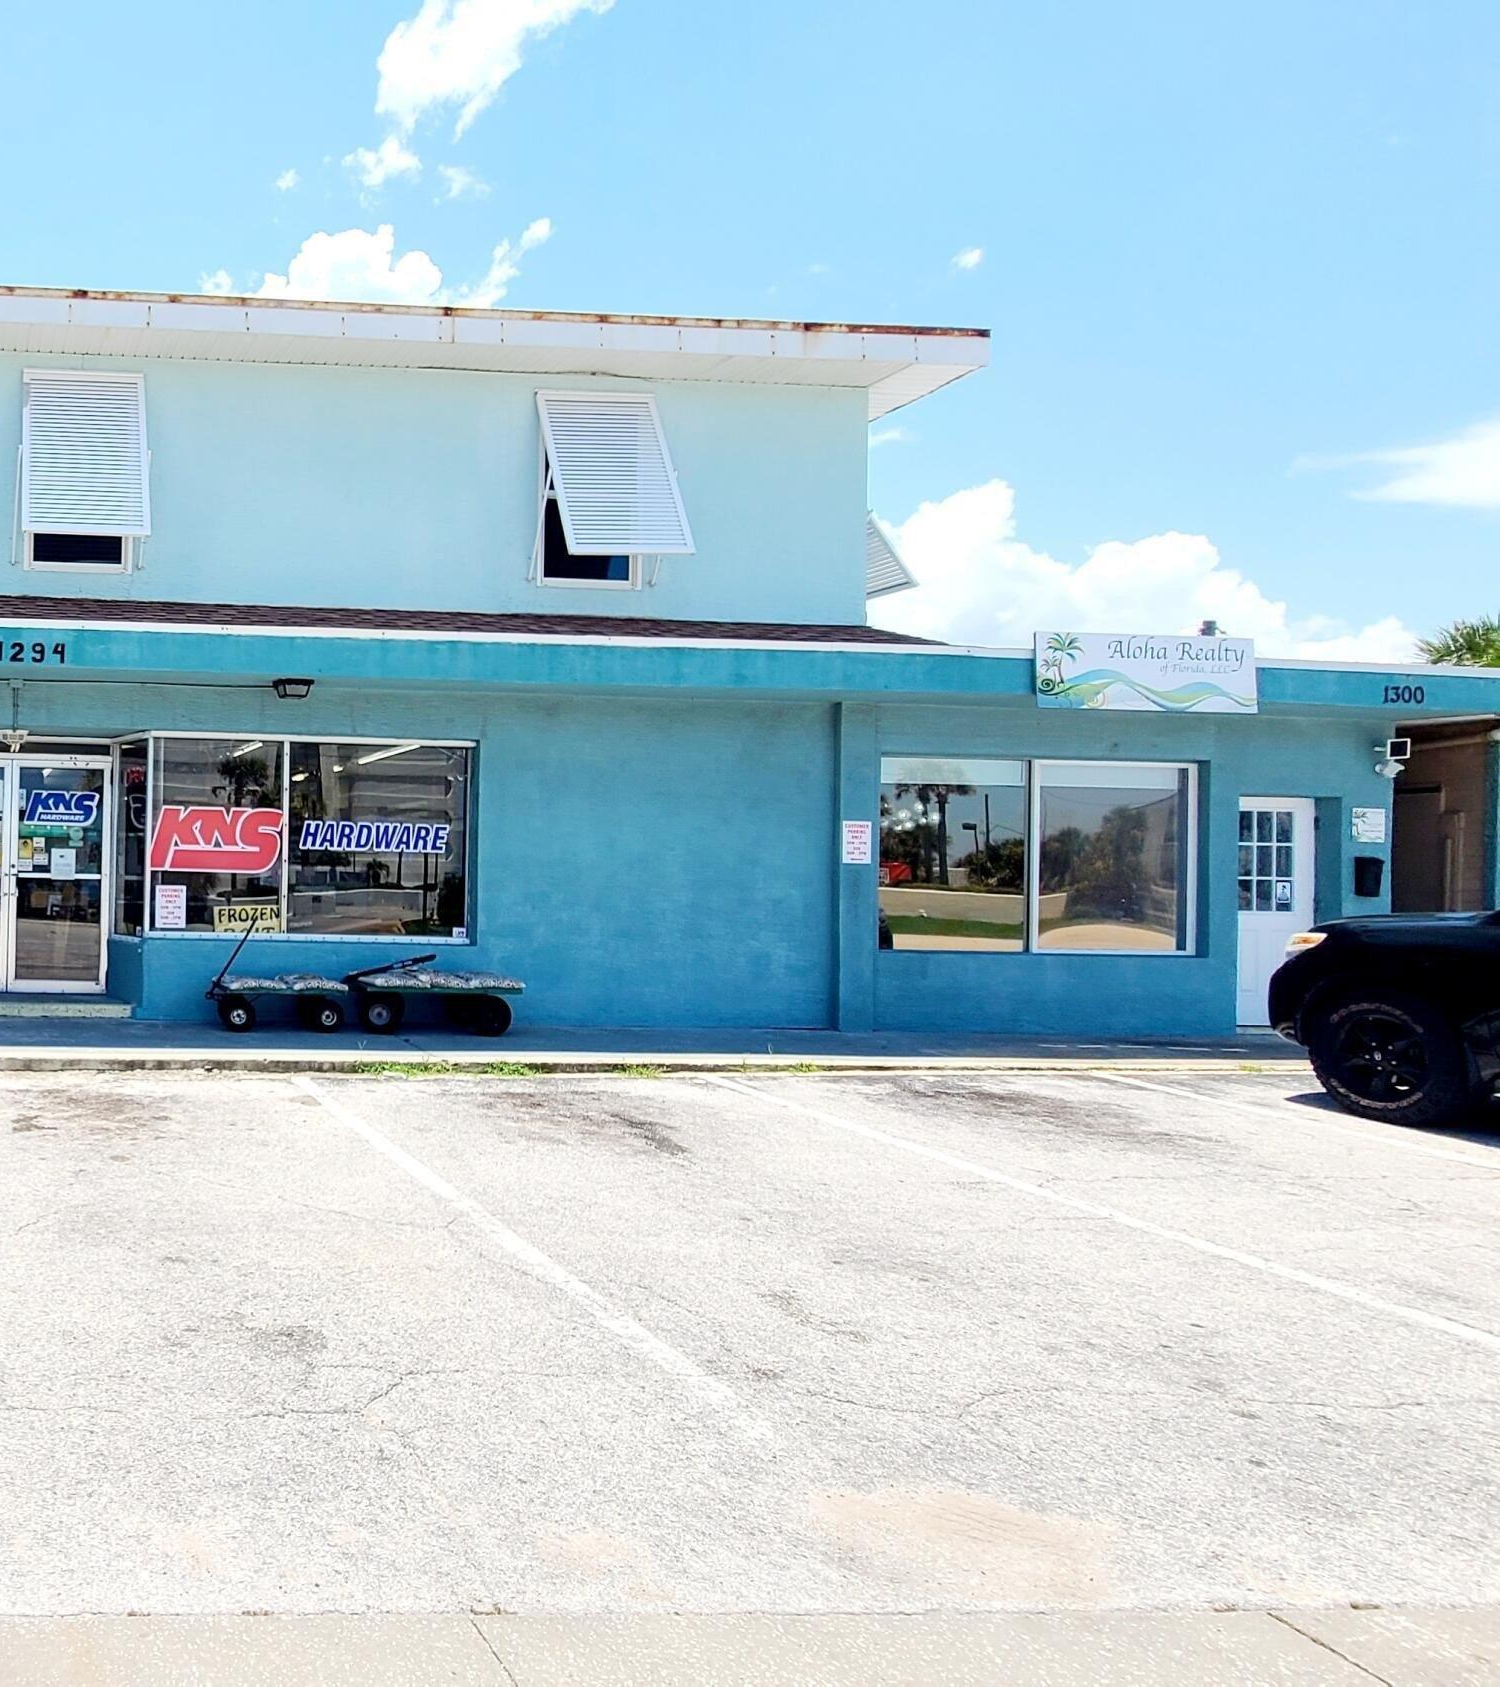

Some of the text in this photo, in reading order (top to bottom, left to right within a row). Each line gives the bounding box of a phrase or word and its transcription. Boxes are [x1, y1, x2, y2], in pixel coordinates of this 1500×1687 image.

[1108, 635, 1244, 672] Aloha Realty
[1160, 661, 1169, 677] of
[1382, 685, 1425, 704] 1300
[24, 790, 100, 826] KNS
[150, 805, 284, 873] KNS
[299, 820, 450, 853] HARDWARE
[218, 907, 280, 923] FROZEN
